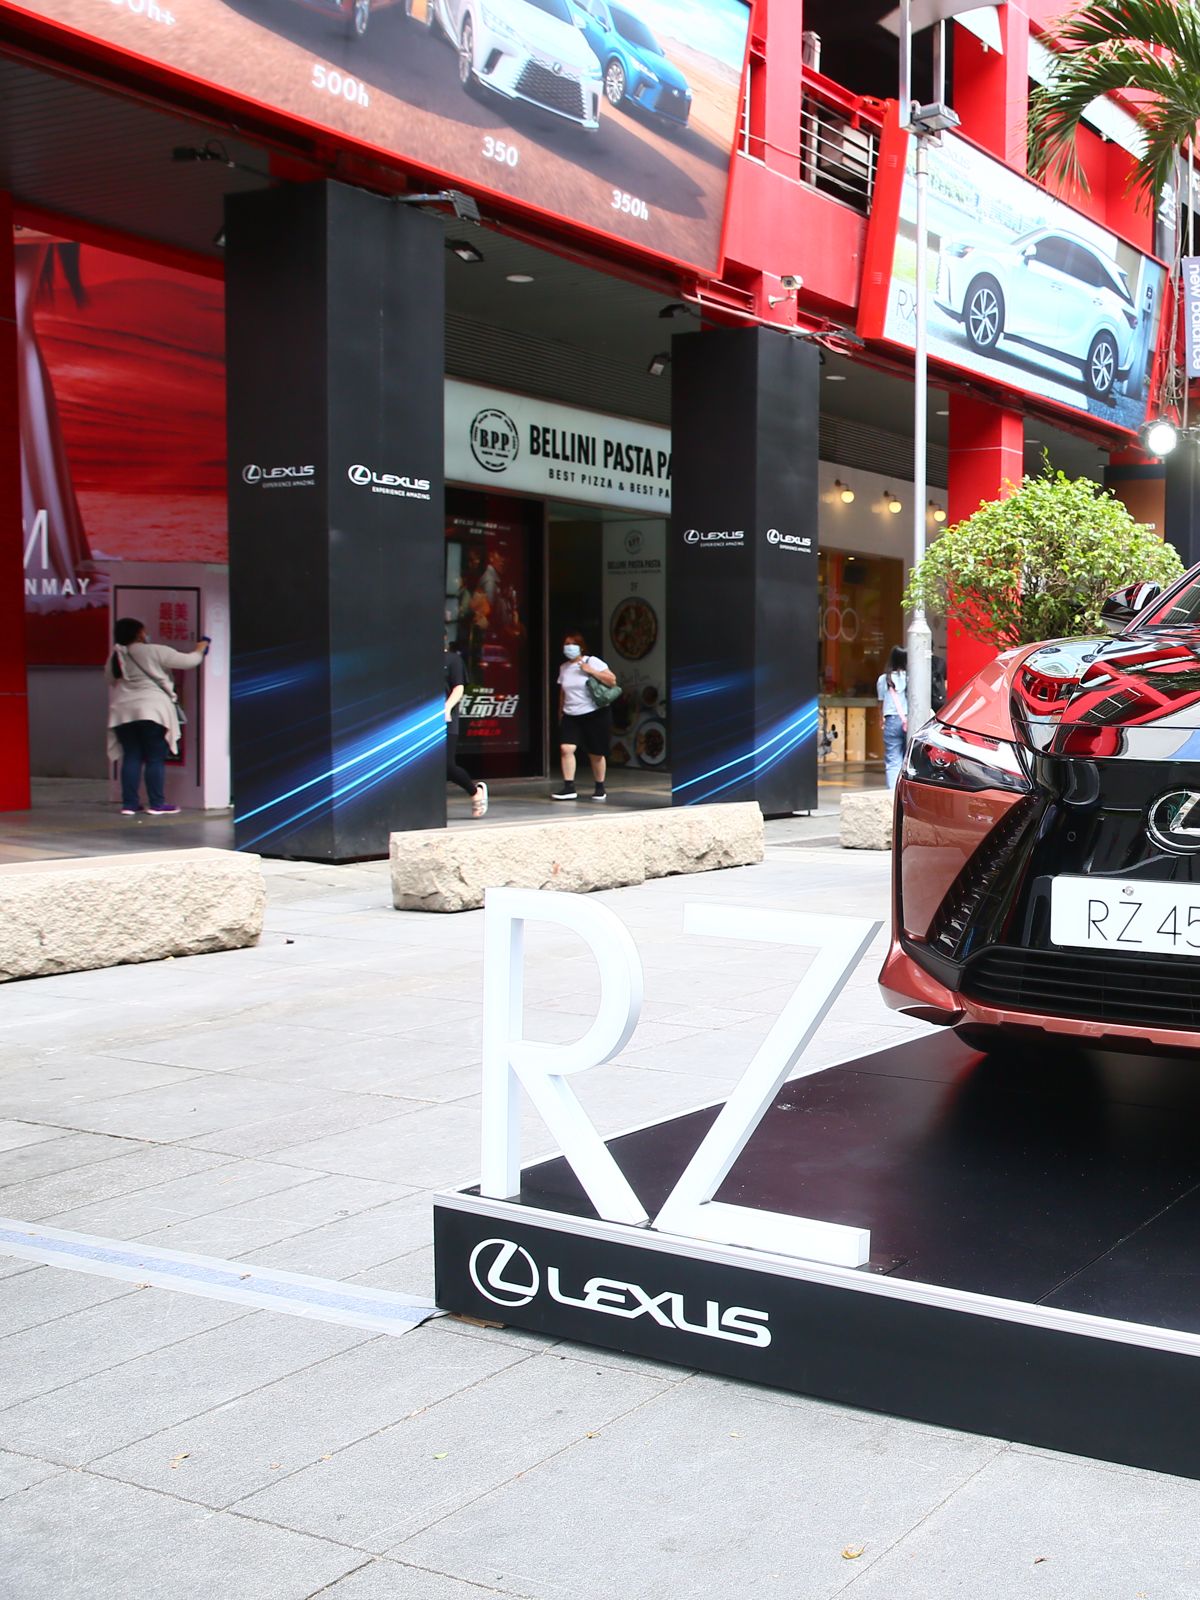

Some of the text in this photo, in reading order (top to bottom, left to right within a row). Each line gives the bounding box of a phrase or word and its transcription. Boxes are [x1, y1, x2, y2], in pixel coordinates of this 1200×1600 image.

[112, 0, 176, 26] 0h+
[311, 63, 369, 107] 500h
[482, 136, 518, 167] 350
[611, 189, 649, 221] 350h
[530, 424, 596, 466] BELLINI
[603, 440, 654, 477] PASTA
[262, 465, 315, 479] LEXUS
[372, 472, 431, 491] LEXUS
[549, 468, 575, 482] BEST
[581, 474, 612, 489] PIZZA
[618, 481, 625, 491] &
[630, 483, 653, 496] BEST
[371, 486, 431, 501] EXPERIENCE AMAZING
[700, 530, 744, 540] LEXUS
[780, 533, 812, 546] LEXUS
[25, 577, 90, 596] NMAY
[1087, 898, 1143, 944] RZ
[480, 887, 885, 1269] RZ
[547, 1266, 772, 1348] LEXUS
